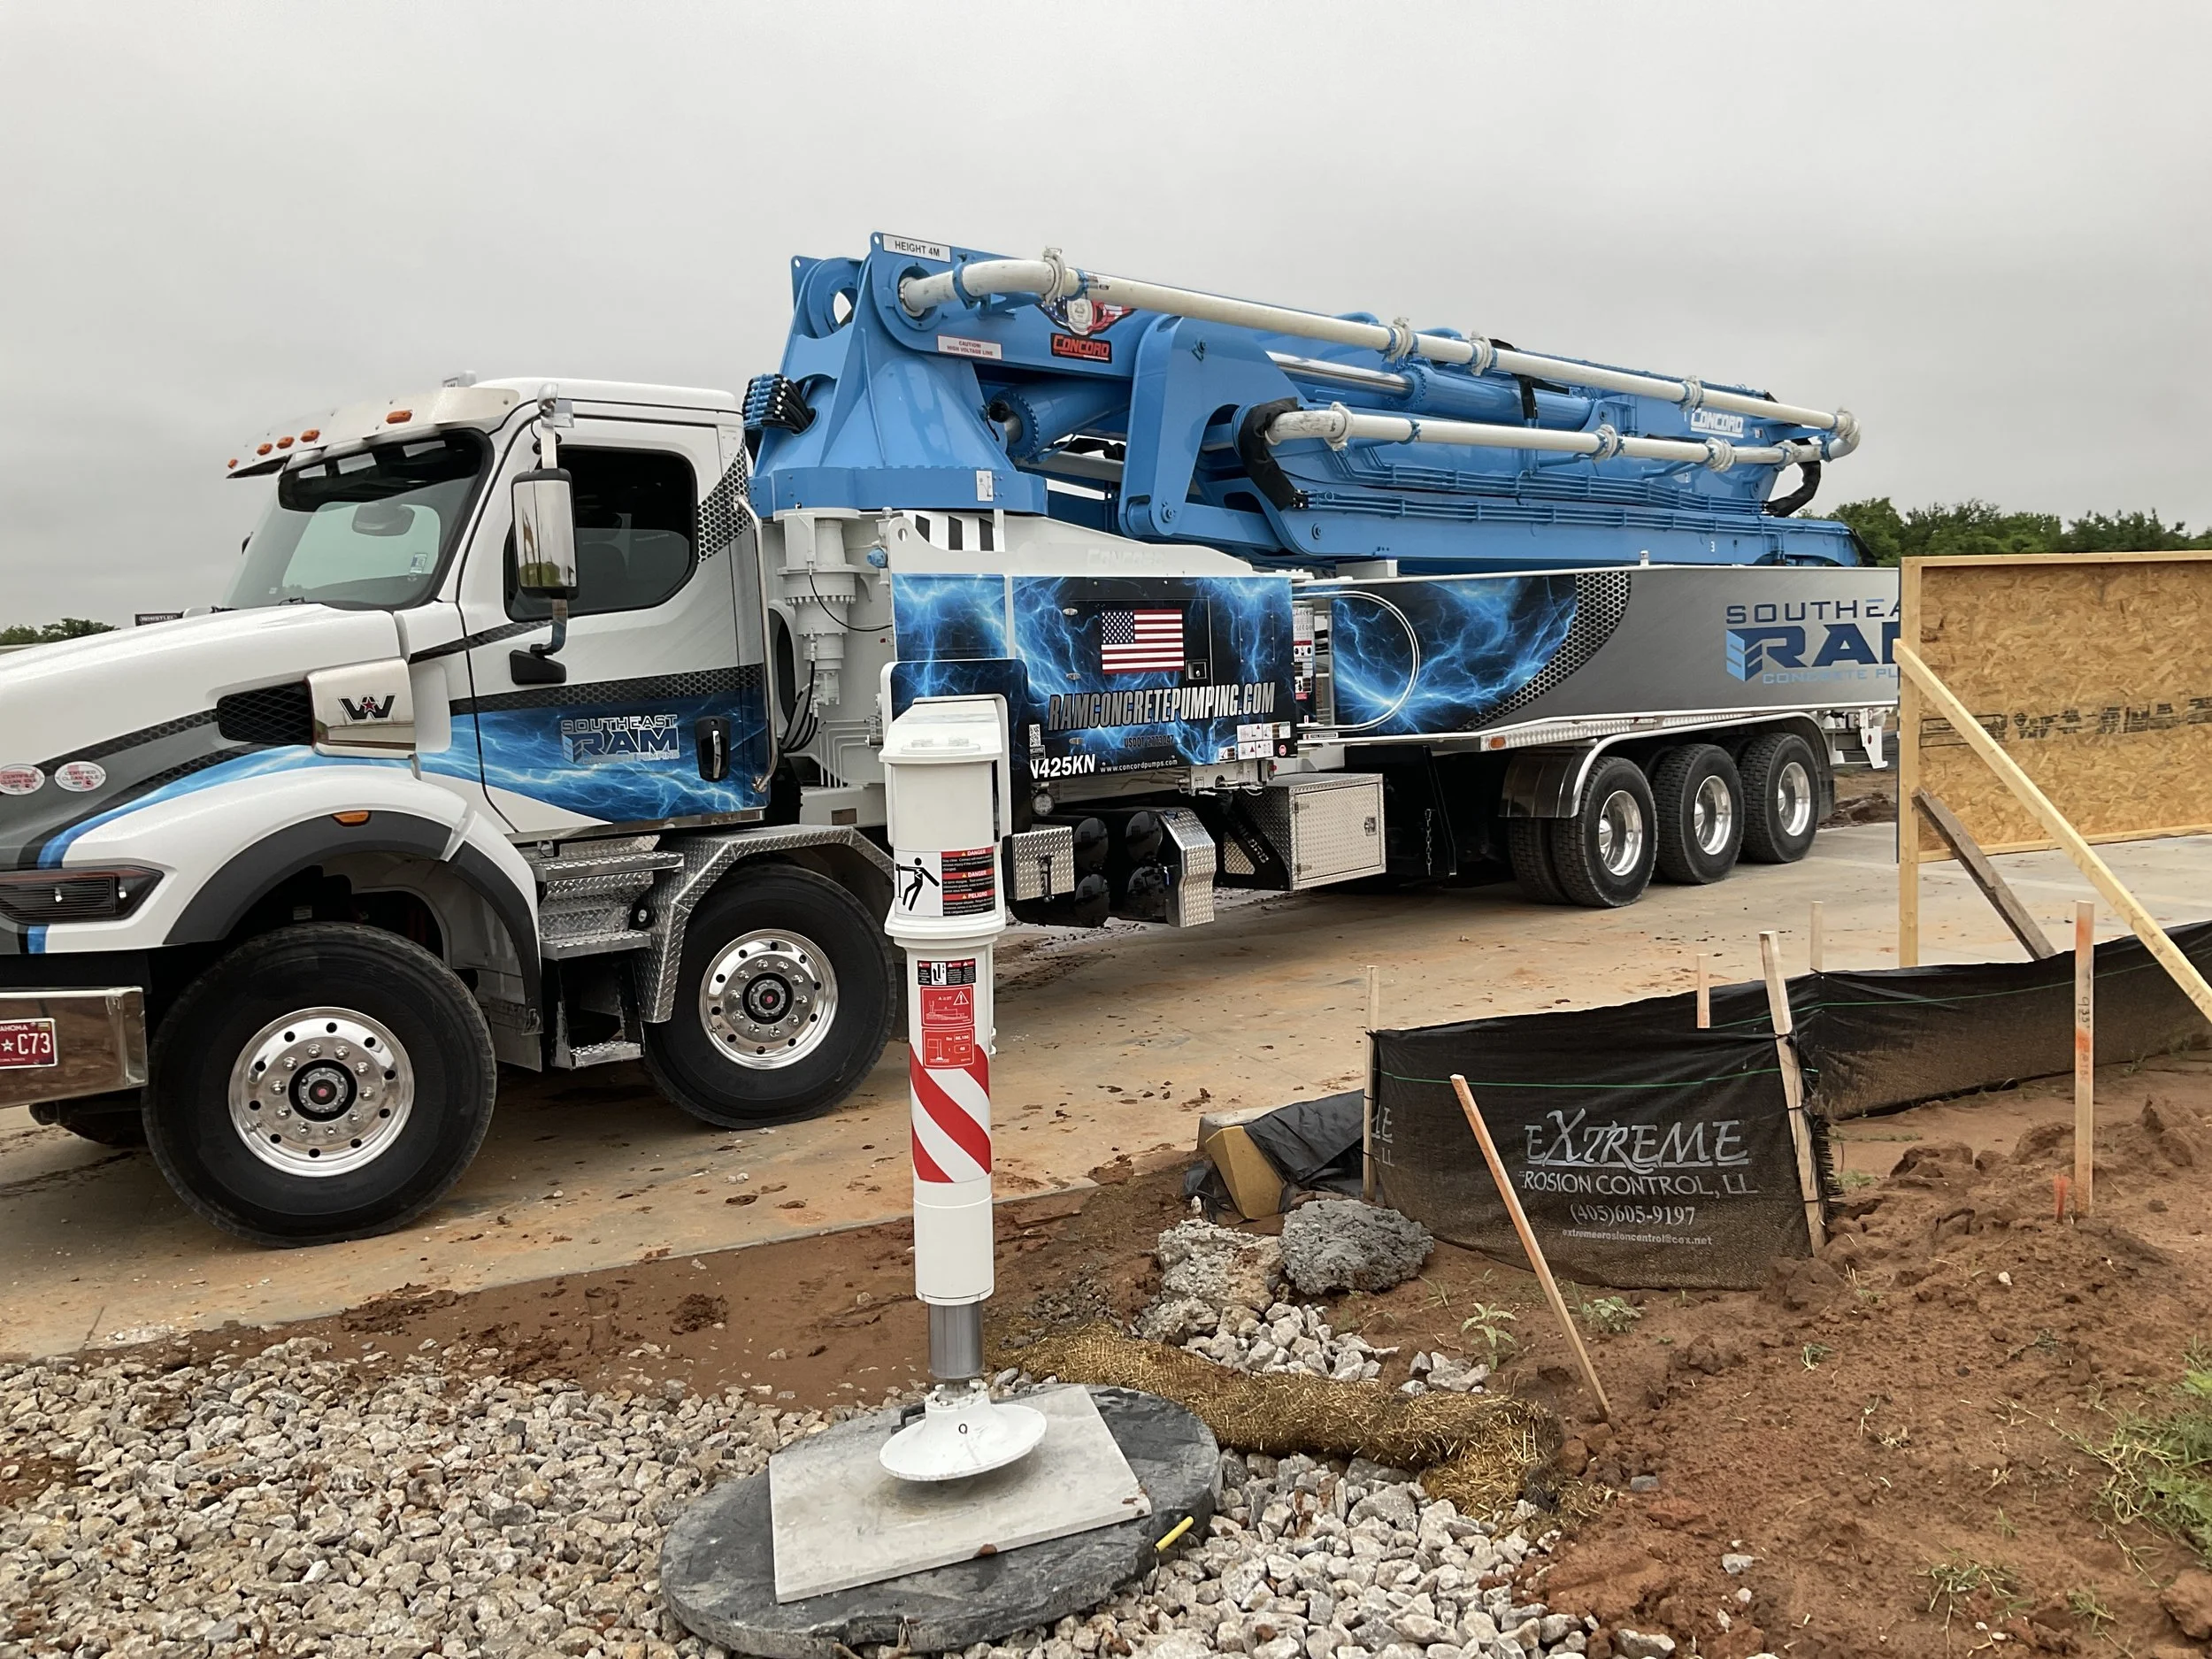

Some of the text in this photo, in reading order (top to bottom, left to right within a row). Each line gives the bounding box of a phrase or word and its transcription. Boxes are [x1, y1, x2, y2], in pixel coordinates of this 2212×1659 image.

[895, 240, 940, 257] HEIGHT 4M
[960, 346, 981, 355] VOLTAGE
[1053, 334, 1110, 357] CONCORD
[1691, 407, 1744, 434] CONCORD
[1048, 681, 1276, 732] RAMCONCRETEPUMPING.COM
[560, 714, 678, 733] SOUTHEAST
[562, 726, 680, 760] RAM
[1124, 736, 1144, 748] USDOT
[1100, 758, 1179, 773] www.concordpumps.com
[17, 1032, 51, 1055] C73
[1524, 1107, 1748, 1175] EXTREME
[1518, 1170, 1592, 1194] ROSION
[1595, 1174, 1720, 1199] CONTROL,
[1570, 1203, 1695, 1226] (405)605-9197
[1562, 1228, 1713, 1246] extremeerosioncontrol@cox.net
